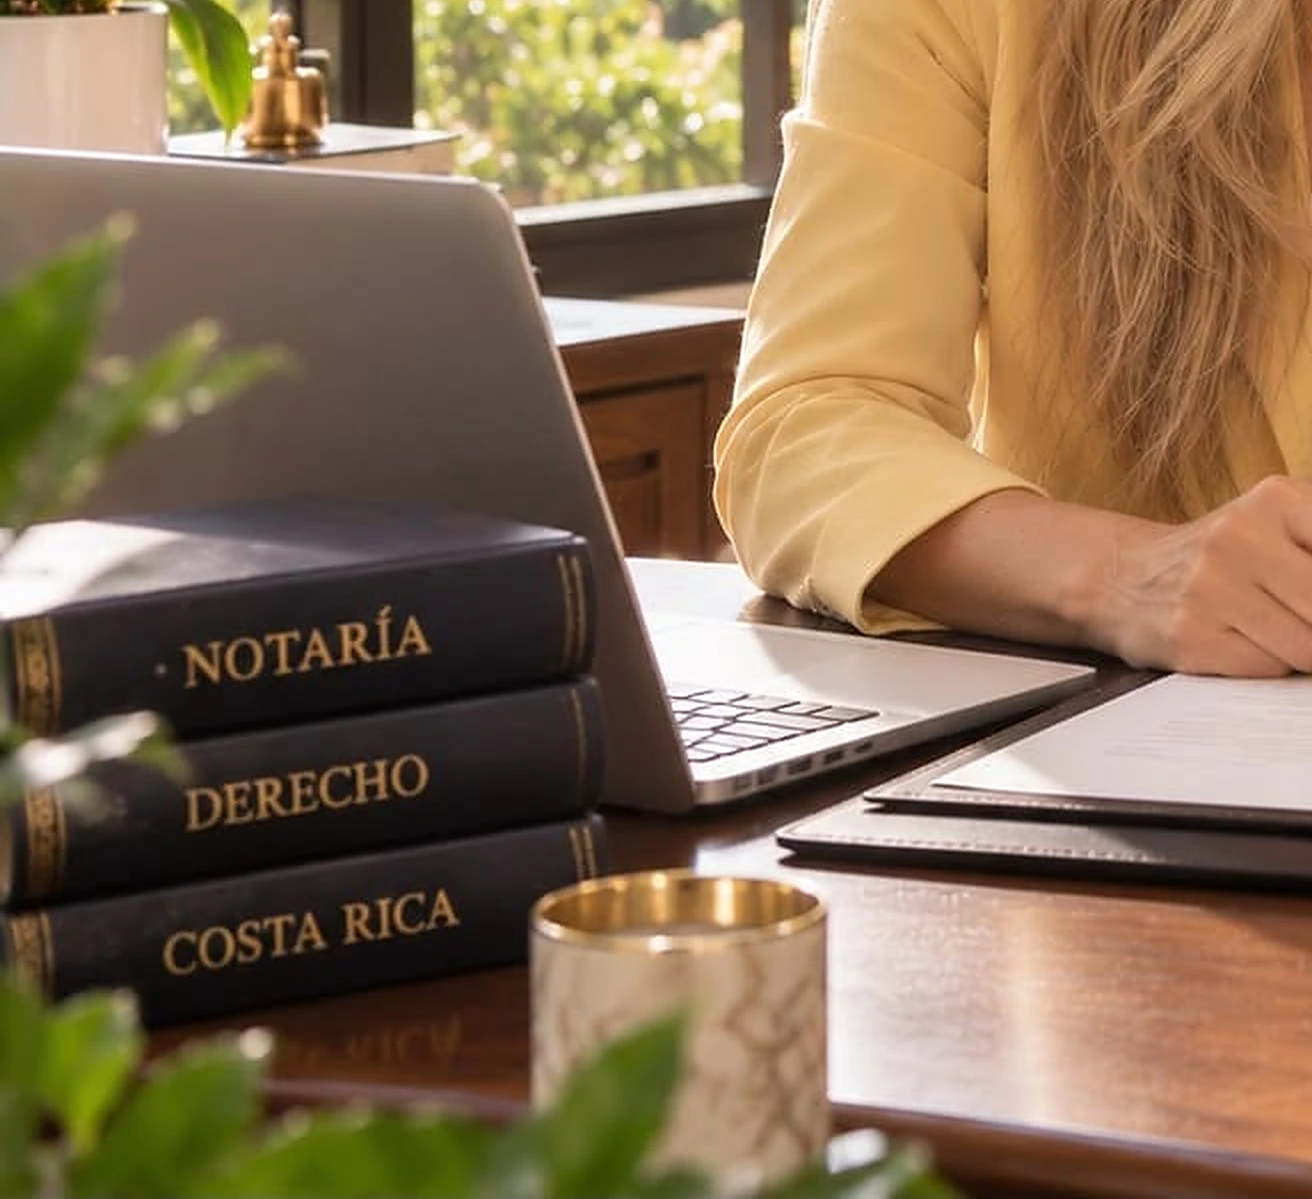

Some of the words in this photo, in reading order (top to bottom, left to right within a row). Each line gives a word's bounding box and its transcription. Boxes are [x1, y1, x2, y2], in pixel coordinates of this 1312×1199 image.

[182, 605, 433, 689] NOTARÍA
[185, 753, 431, 832] DERECHO
[162, 911, 328, 977] COSTA
[342, 888, 460, 947] RICA
